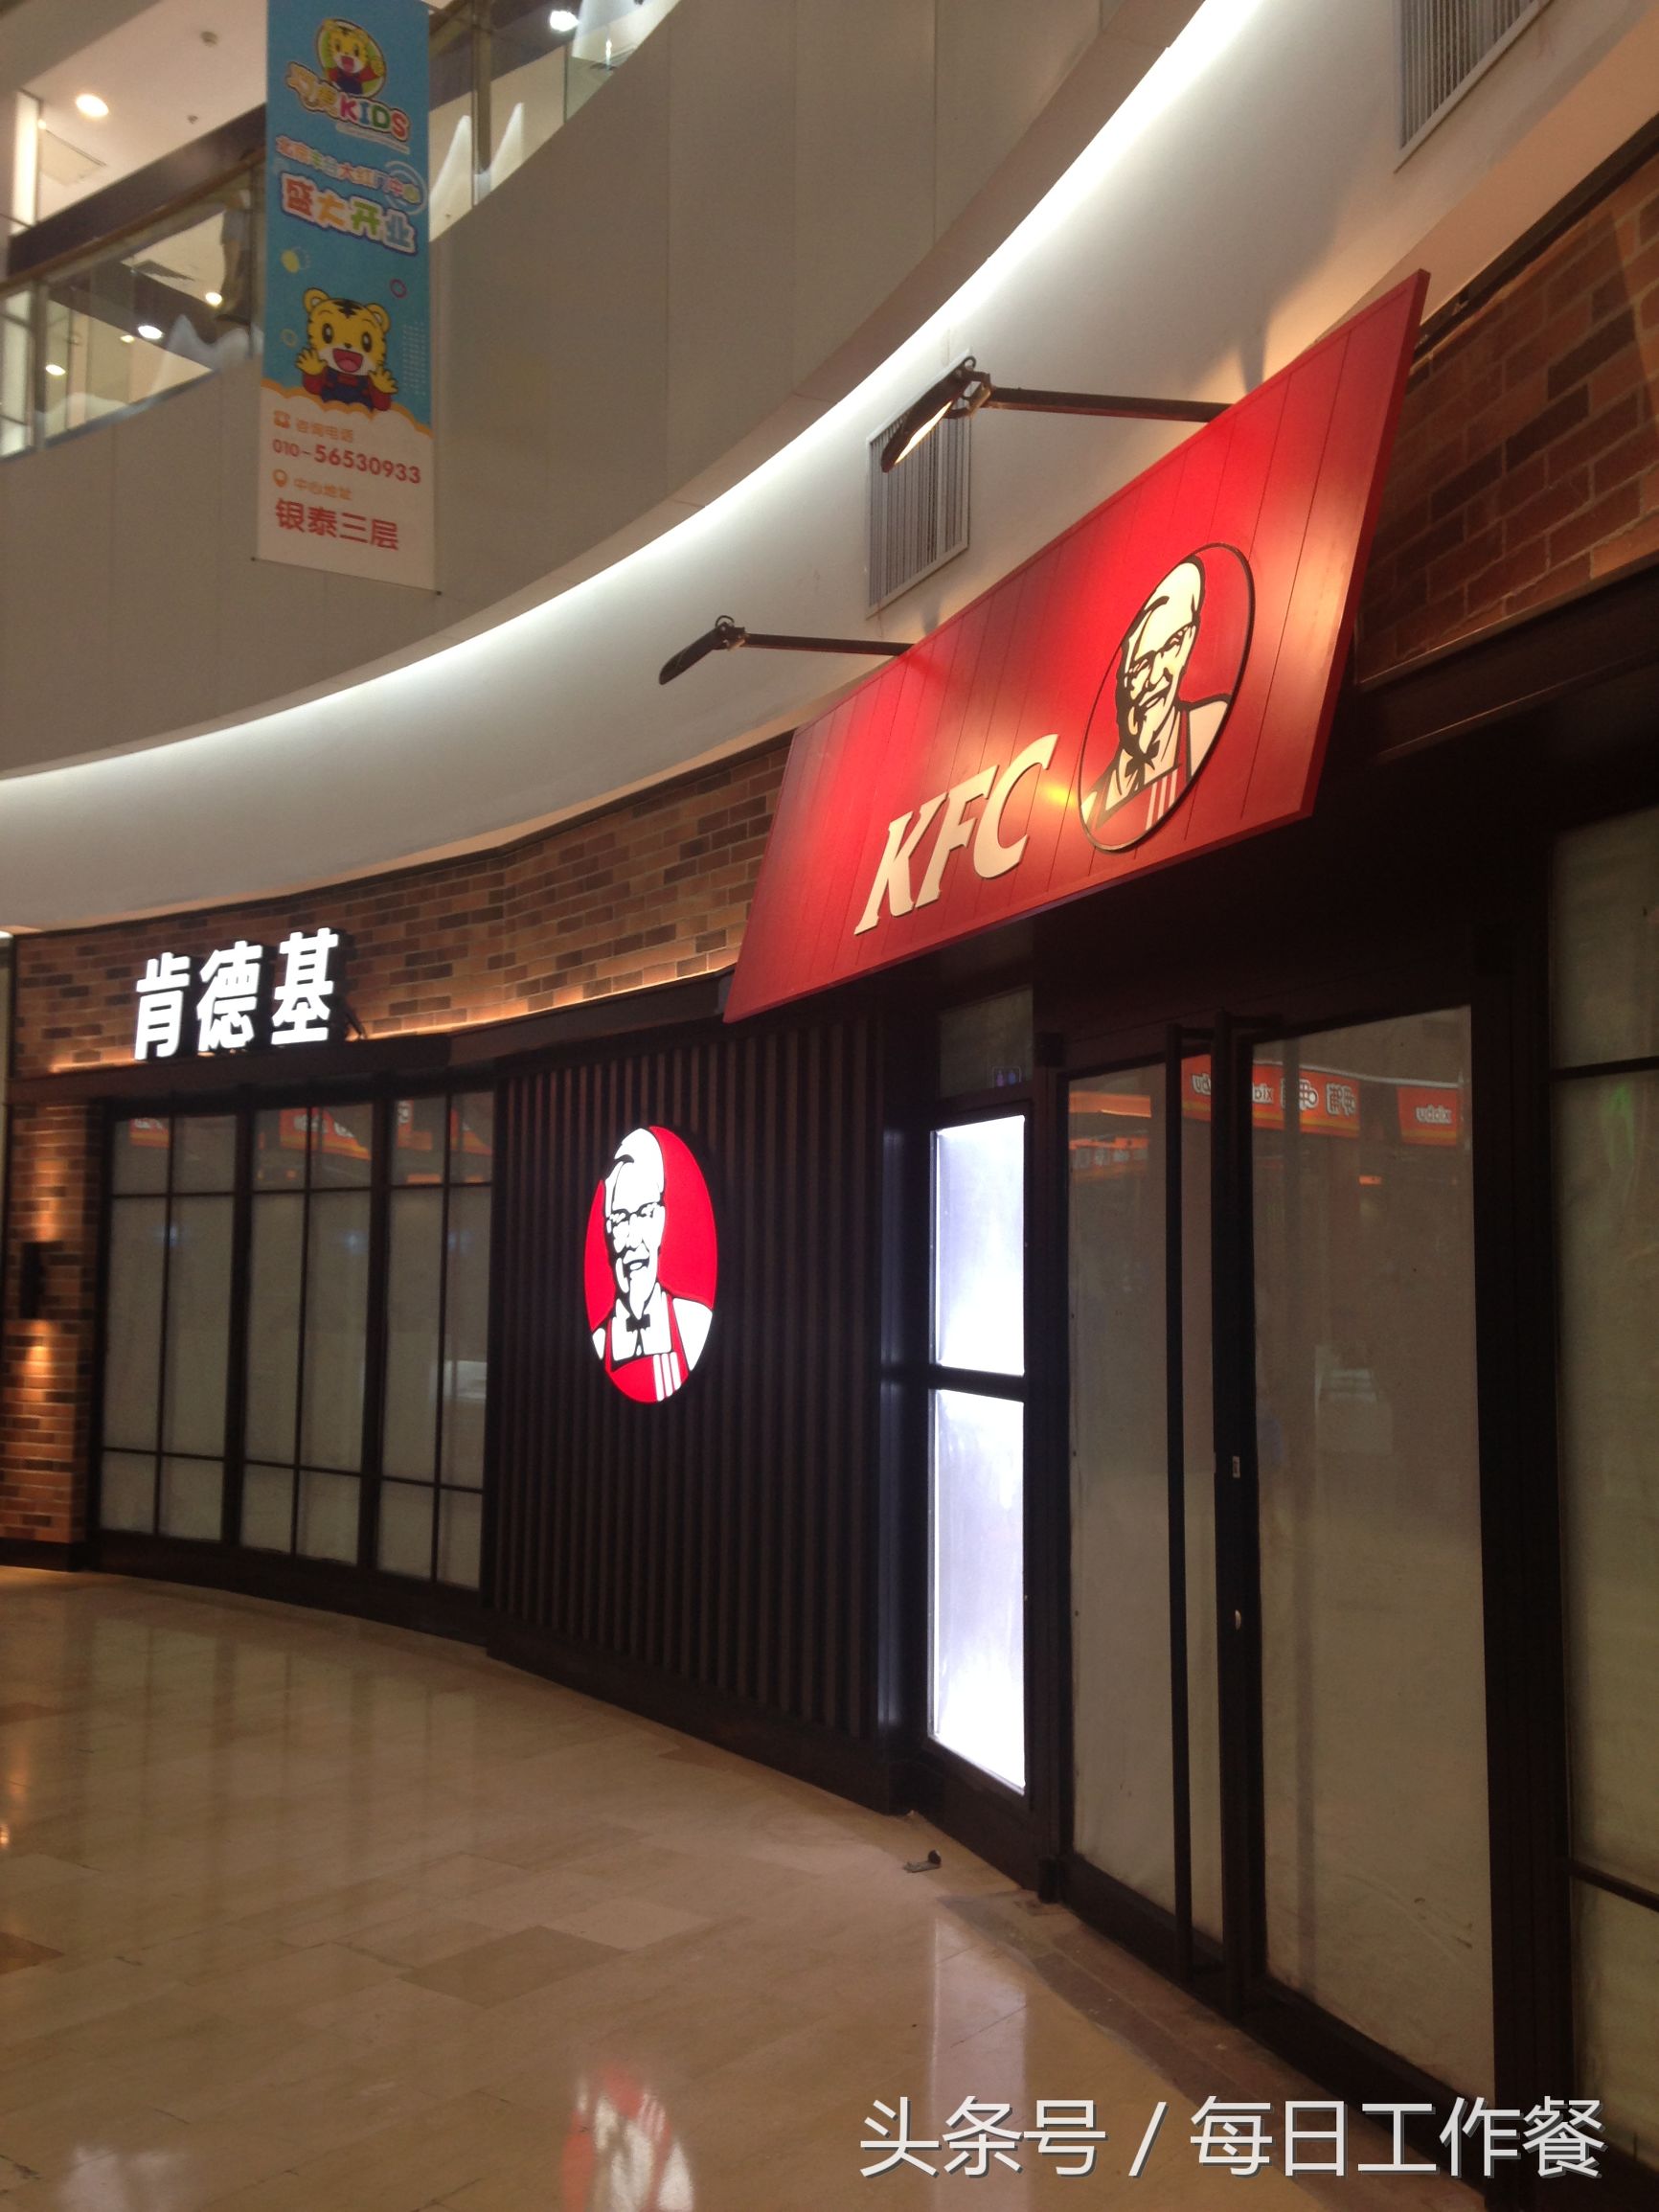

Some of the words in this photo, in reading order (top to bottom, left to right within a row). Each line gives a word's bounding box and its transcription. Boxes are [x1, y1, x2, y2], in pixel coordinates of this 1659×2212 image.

[283, 173, 416, 253] 盛大开业
[272, 439, 421, 484] 010-56530933
[275, 498, 399, 551] 银泰三层
[853, 734, 1058, 936] KFC
[134, 927, 339, 1060] 肯德基
